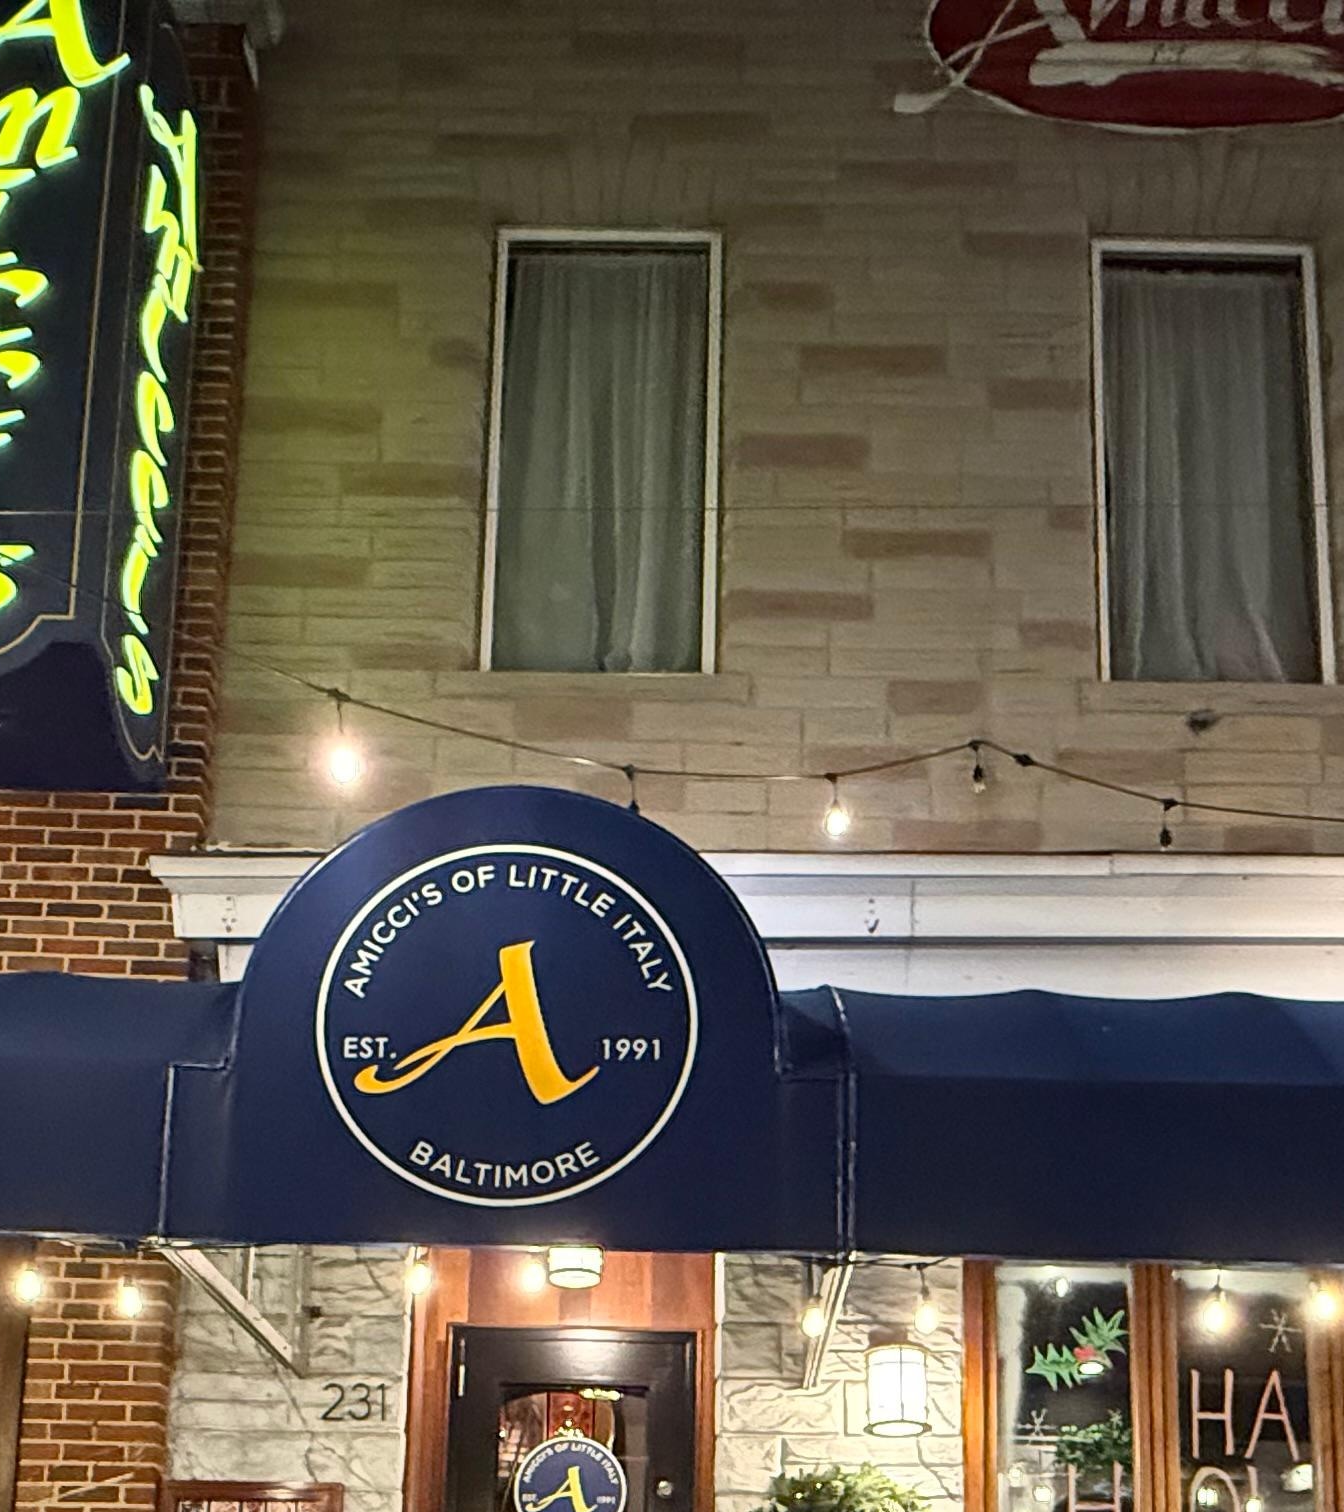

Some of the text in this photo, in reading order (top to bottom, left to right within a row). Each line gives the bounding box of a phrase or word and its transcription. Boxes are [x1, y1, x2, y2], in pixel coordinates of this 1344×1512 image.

[344, 864, 674, 999] AMICCI'S OF LITTLE ITALY
[354, 939, 601, 1105] A
[342, 1036, 397, 1060] EST.
[601, 1038, 662, 1061] 1991
[408, 1140, 601, 1189] BALTIMORE
[320, 1382, 386, 1422] 231
